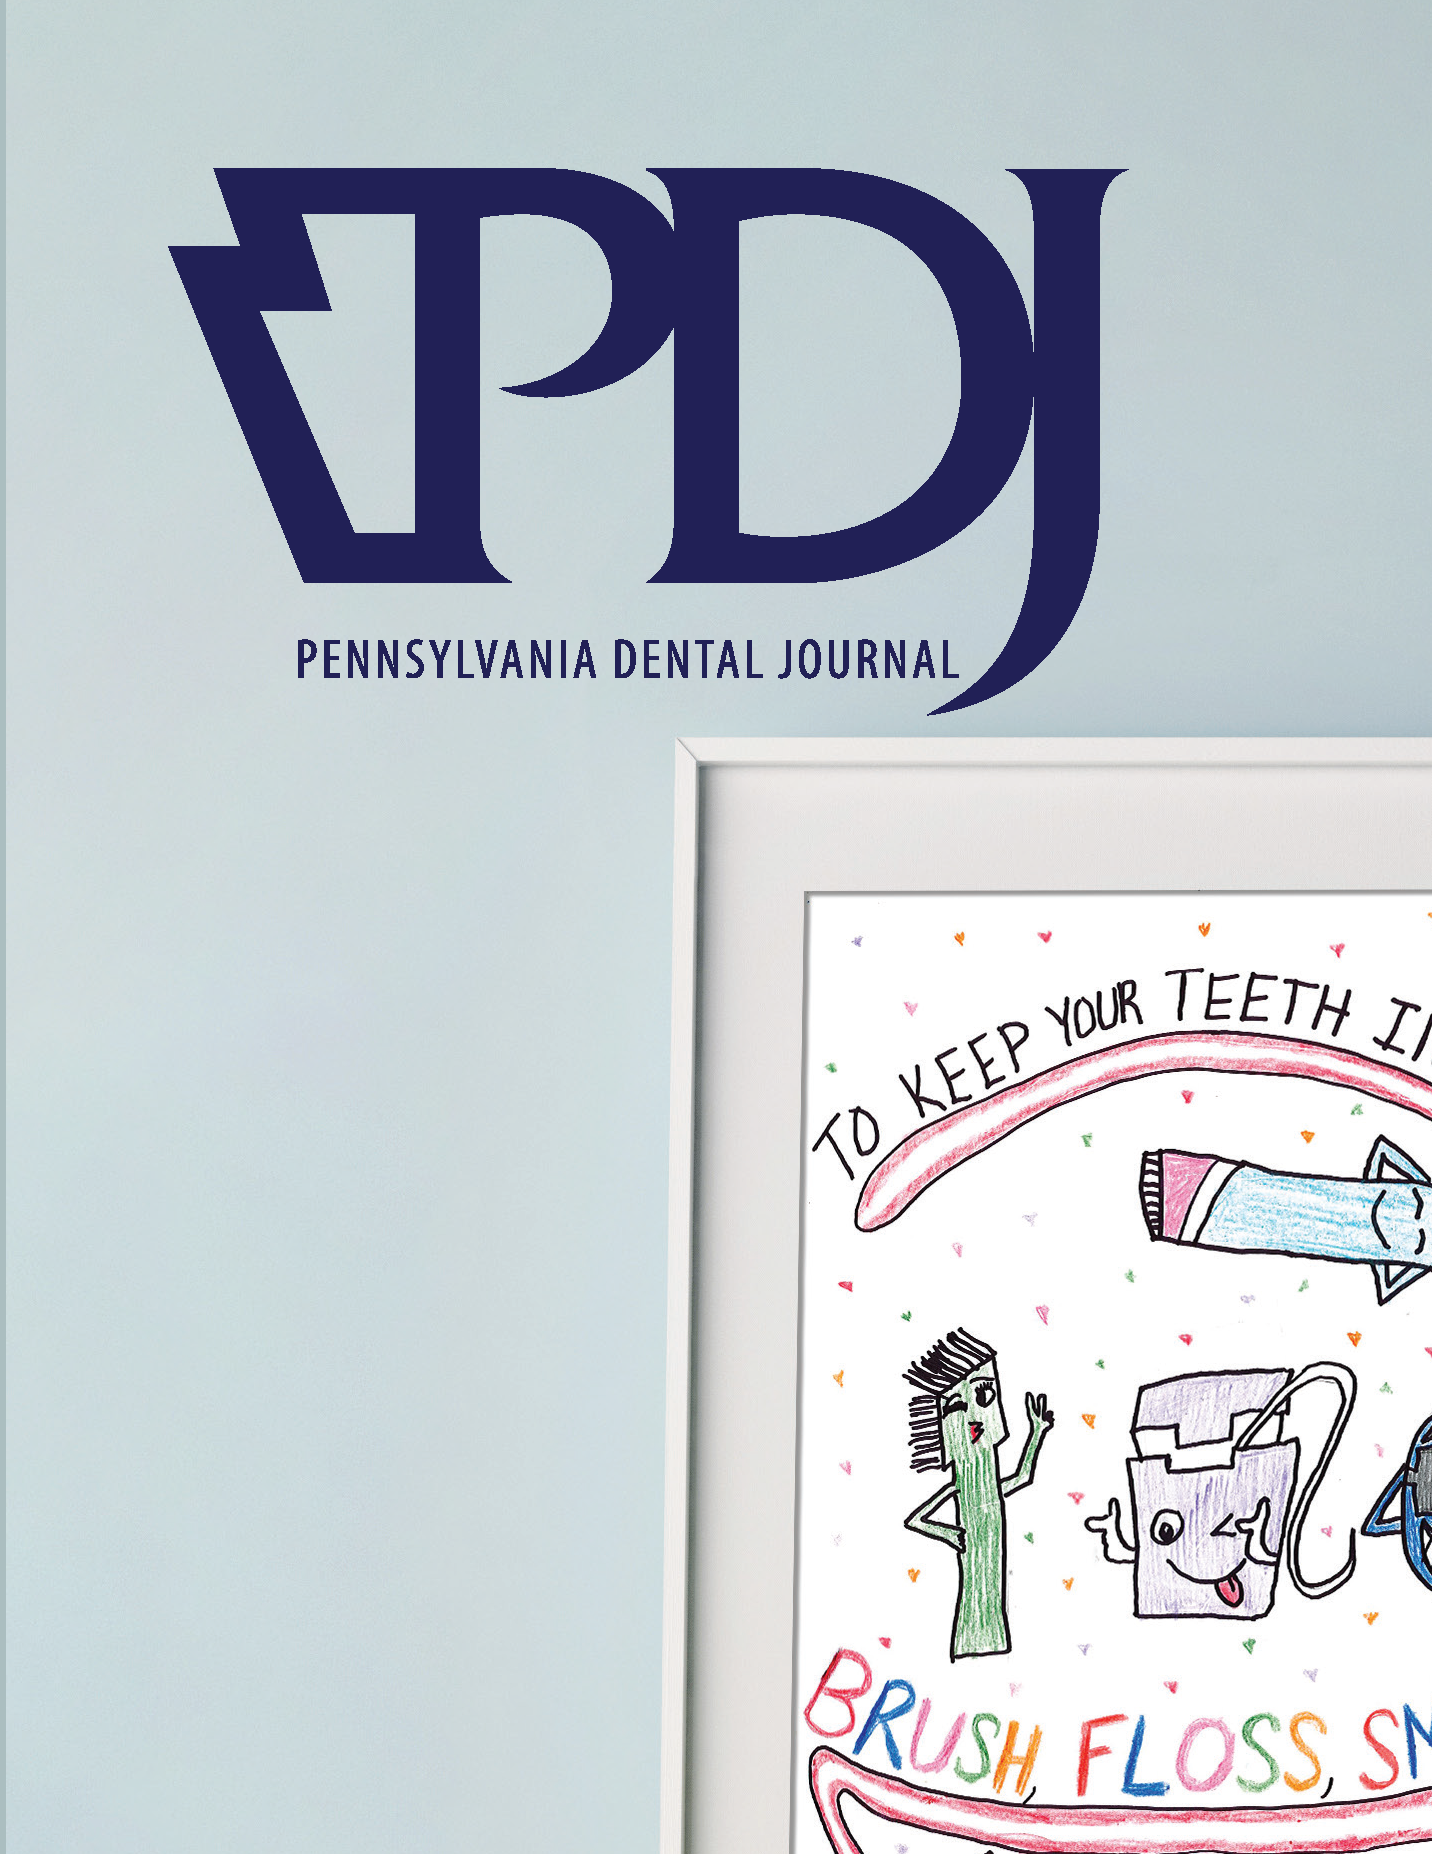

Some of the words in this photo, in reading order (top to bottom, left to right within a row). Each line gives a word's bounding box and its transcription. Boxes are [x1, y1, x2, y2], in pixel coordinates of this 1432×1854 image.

[813, 1107, 879, 1181] TO
[900, 1021, 1030, 1118] KEEP
[1046, 978, 1142, 1046] YOUR
[1165, 968, 1351, 1037] TEETH
